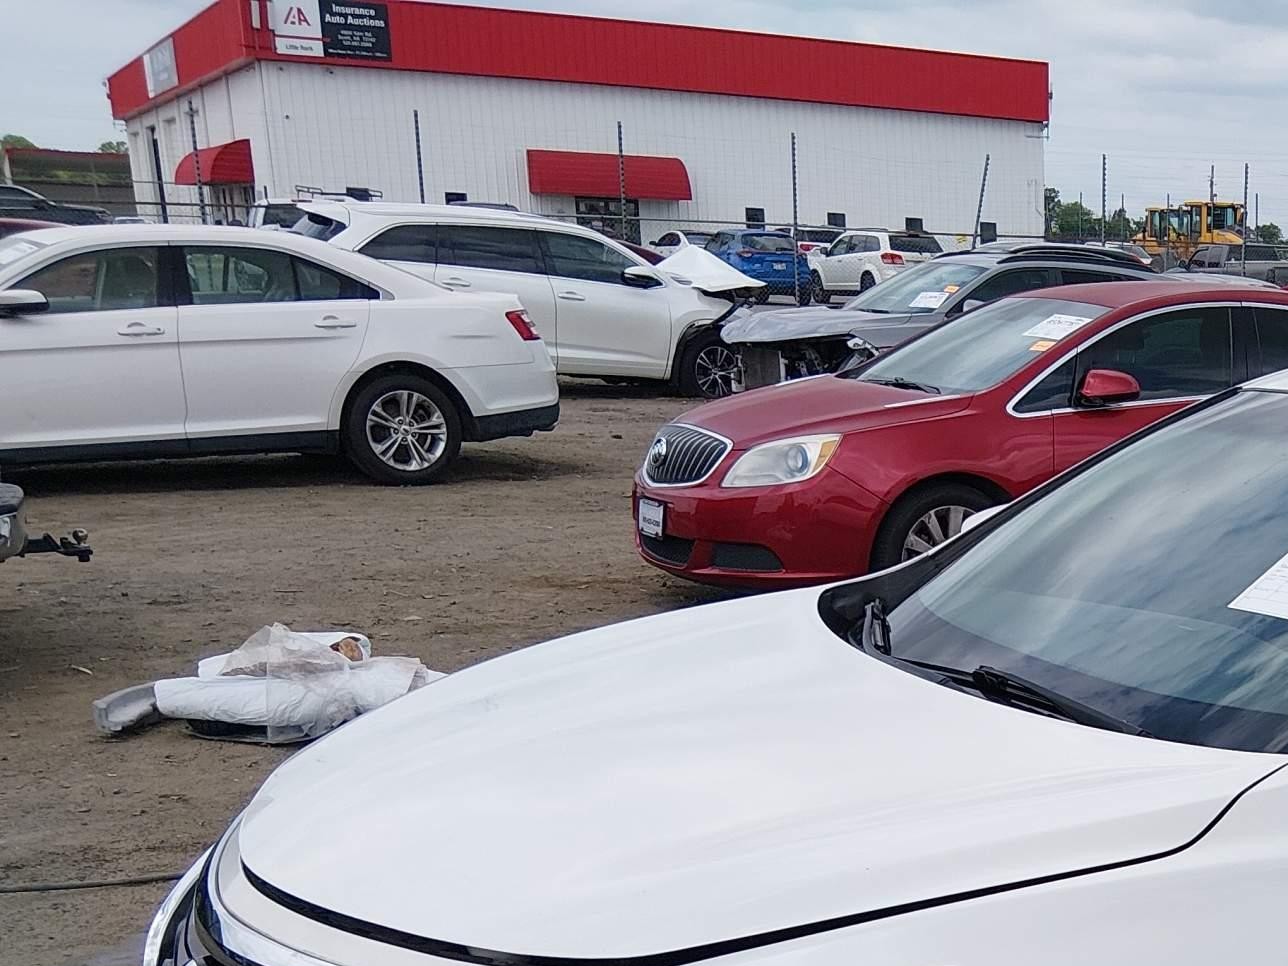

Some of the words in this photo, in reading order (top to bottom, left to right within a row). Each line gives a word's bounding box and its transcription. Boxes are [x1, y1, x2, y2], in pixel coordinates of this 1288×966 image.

[332, 4, 376, 16] Insurance
[325, 14, 346, 24] Auto
[347, 16, 386, 27] Auctions
